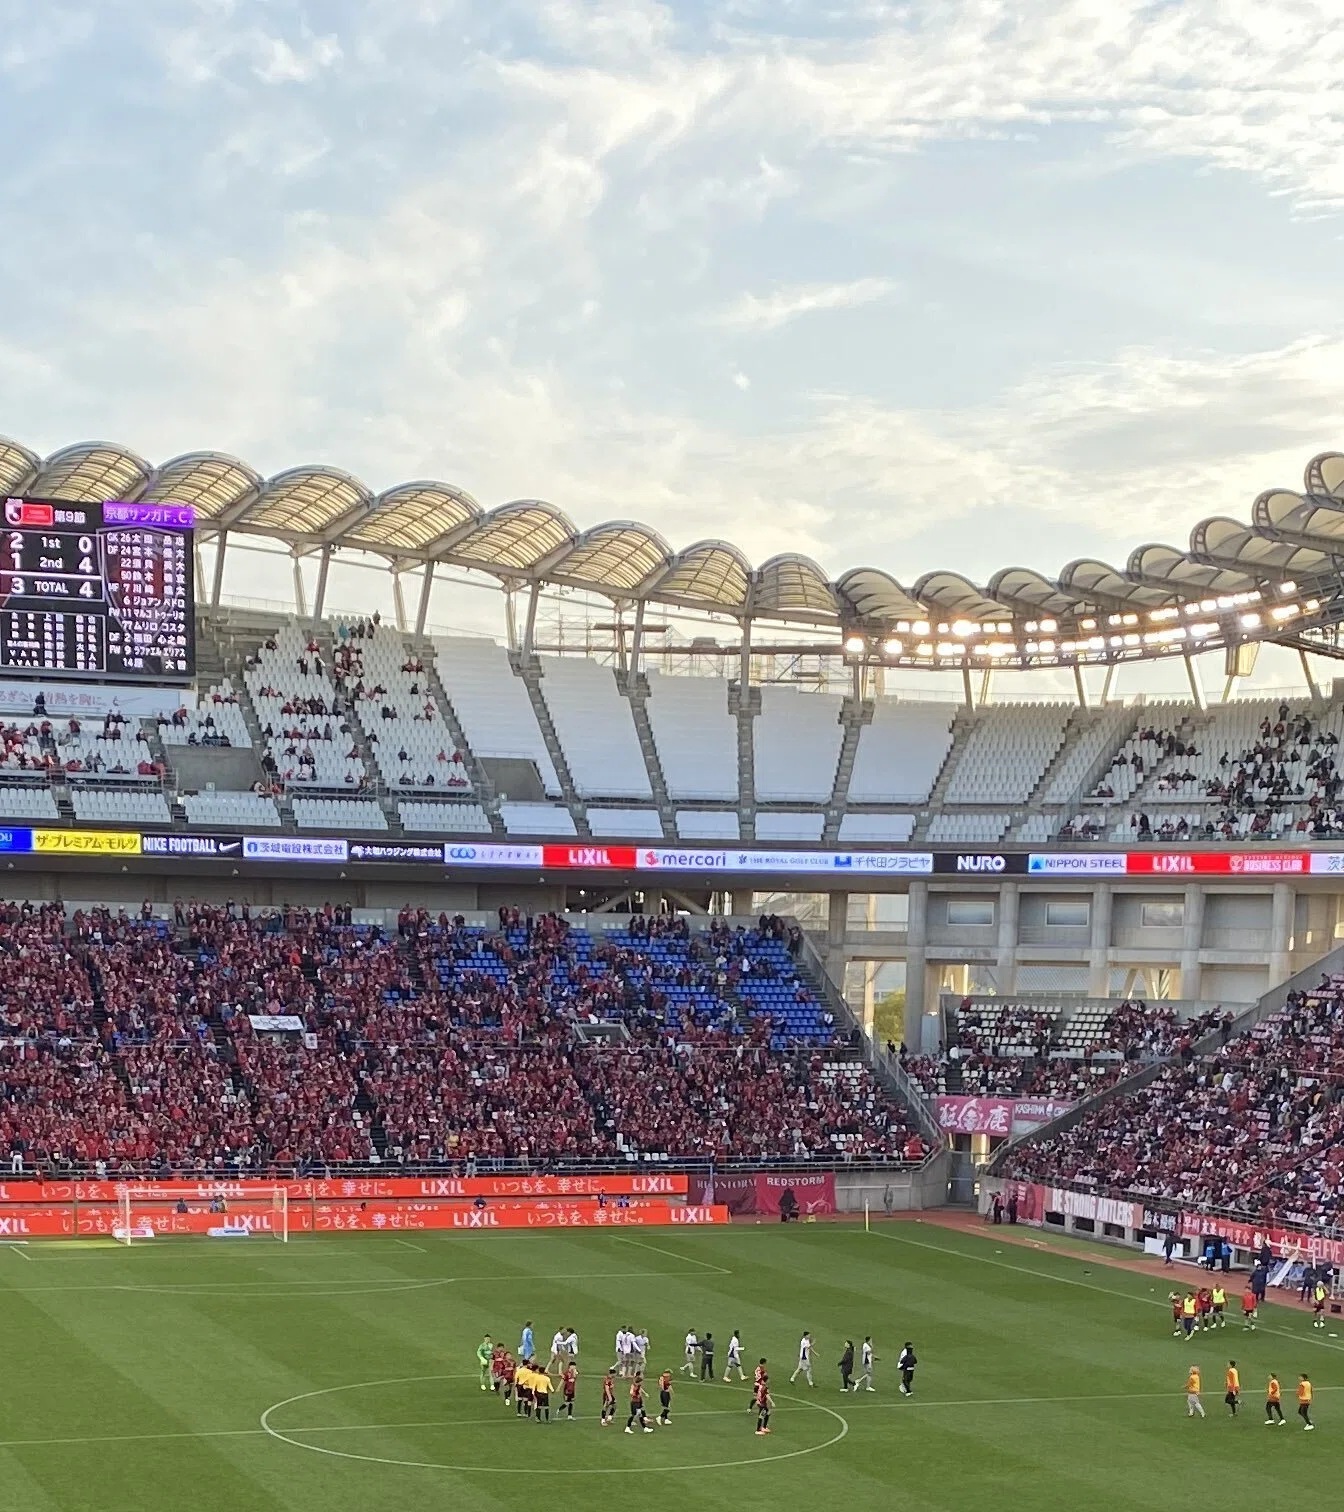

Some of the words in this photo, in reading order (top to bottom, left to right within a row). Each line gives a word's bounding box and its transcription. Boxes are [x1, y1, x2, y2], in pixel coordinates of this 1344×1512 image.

[10, 532, 24, 549] 2
[41, 536, 61, 549] 1st
[78, 536, 92, 553] 0
[11, 552, 21, 569] 1
[39, 556, 63, 569] 2nd
[78, 556, 93, 573] 4
[11, 577, 25, 594] 3
[34, 580, 69, 594] TOTAL
[79, 581, 94, 598] 4
[143, 836, 167, 852] NIKE
[169, 837, 217, 854] FOOTBALL
[568, 849, 611, 864] LIXIL
[662, 852, 726, 867] mercari
[957, 856, 1006, 872] NURO
[1045, 858, 1087, 869] NIPPON
[1089, 857, 1125, 869] STEEL
[1152, 855, 1195, 872] LIXIL
[421, 1179, 465, 1194] LIXIL
[632, 1177, 675, 1191] LIXIL
[767, 1176, 825, 1187] REDSTORM
[1064, 1190, 1096, 1218] STRONG
[1096, 1197, 1134, 1227] ANTLERS
[223, 1214, 271, 1230] LIXIL
[453, 1211, 499, 1226] LIXIL
[670, 1208, 713, 1223] LIXIL
